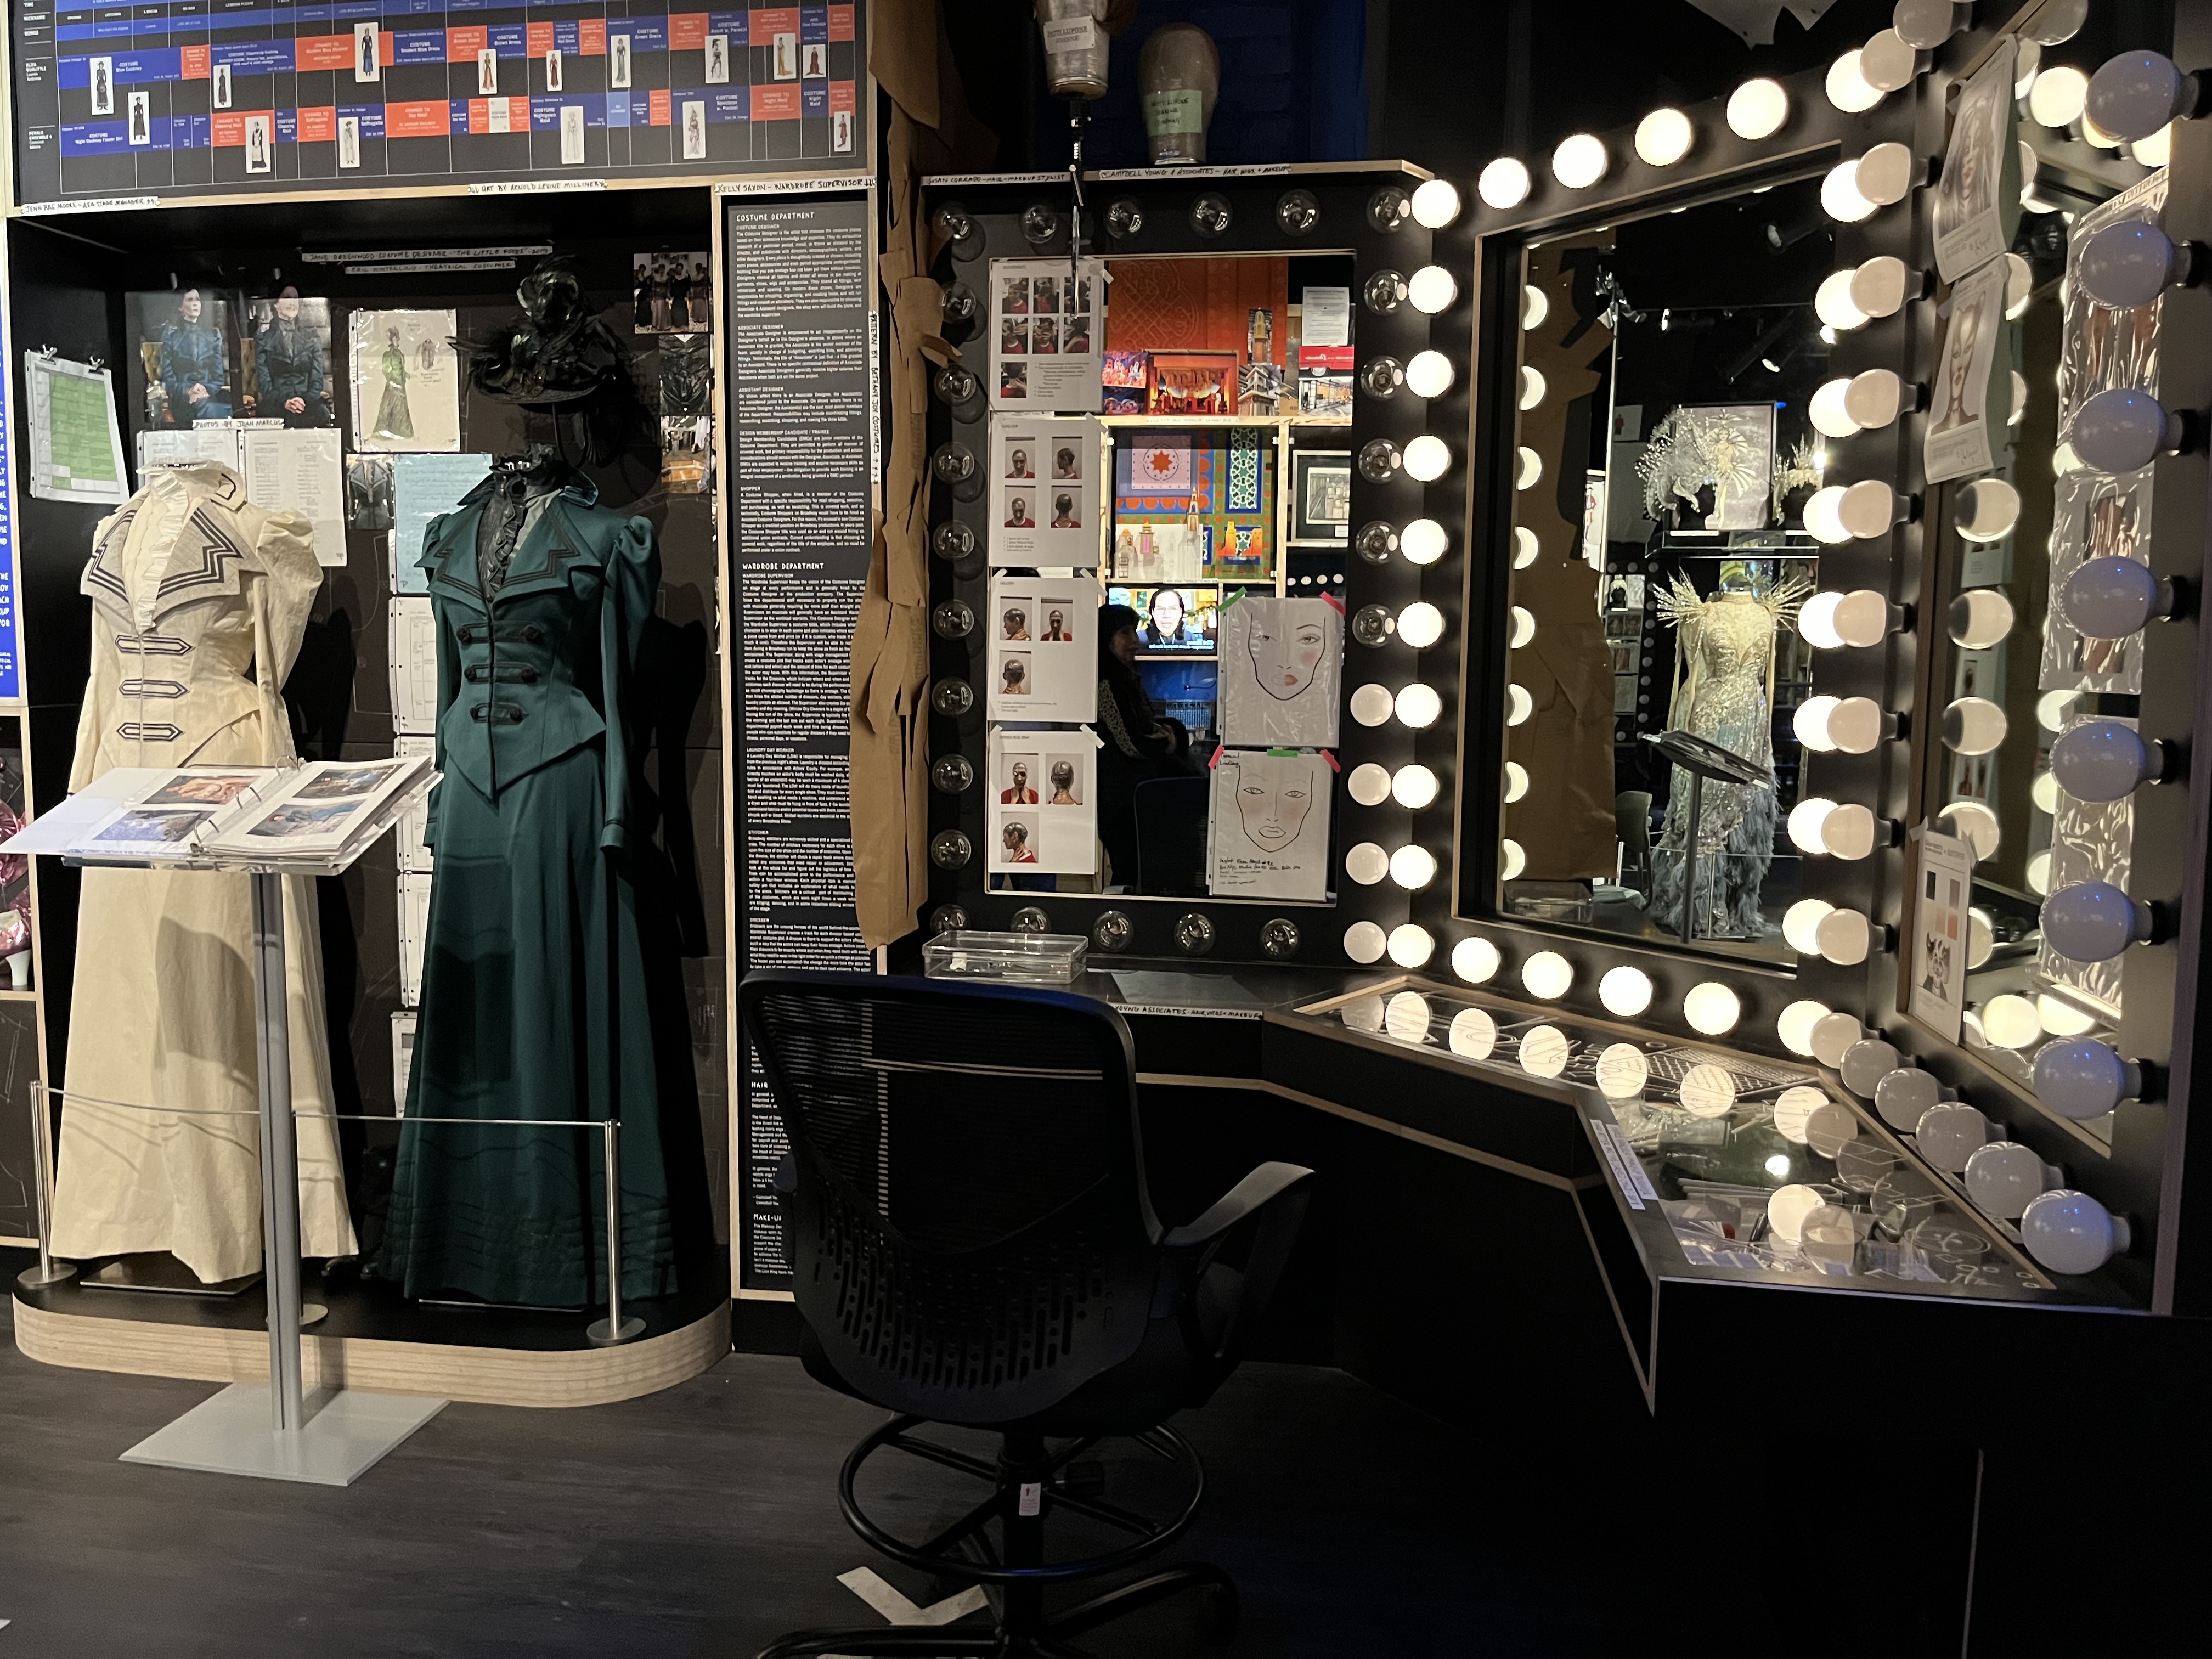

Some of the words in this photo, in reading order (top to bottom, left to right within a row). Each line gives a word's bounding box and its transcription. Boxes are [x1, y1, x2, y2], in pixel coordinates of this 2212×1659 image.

[1176, 167, 1214, 176] ASSOCIATES
[511, 183, 536, 191] ARNOLD
[538, 182, 561, 190] LEVINE
[563, 180, 604, 189] MILLINERY
[718, 184, 741, 193] KELLY
[774, 181, 815, 190] WARDROBE
[817, 179, 862, 189] SUPERVISOR
[736, 213, 768, 222] COSTUME
[771, 211, 815, 221] DEPARTMENT
[871, 350, 878, 359] BY
